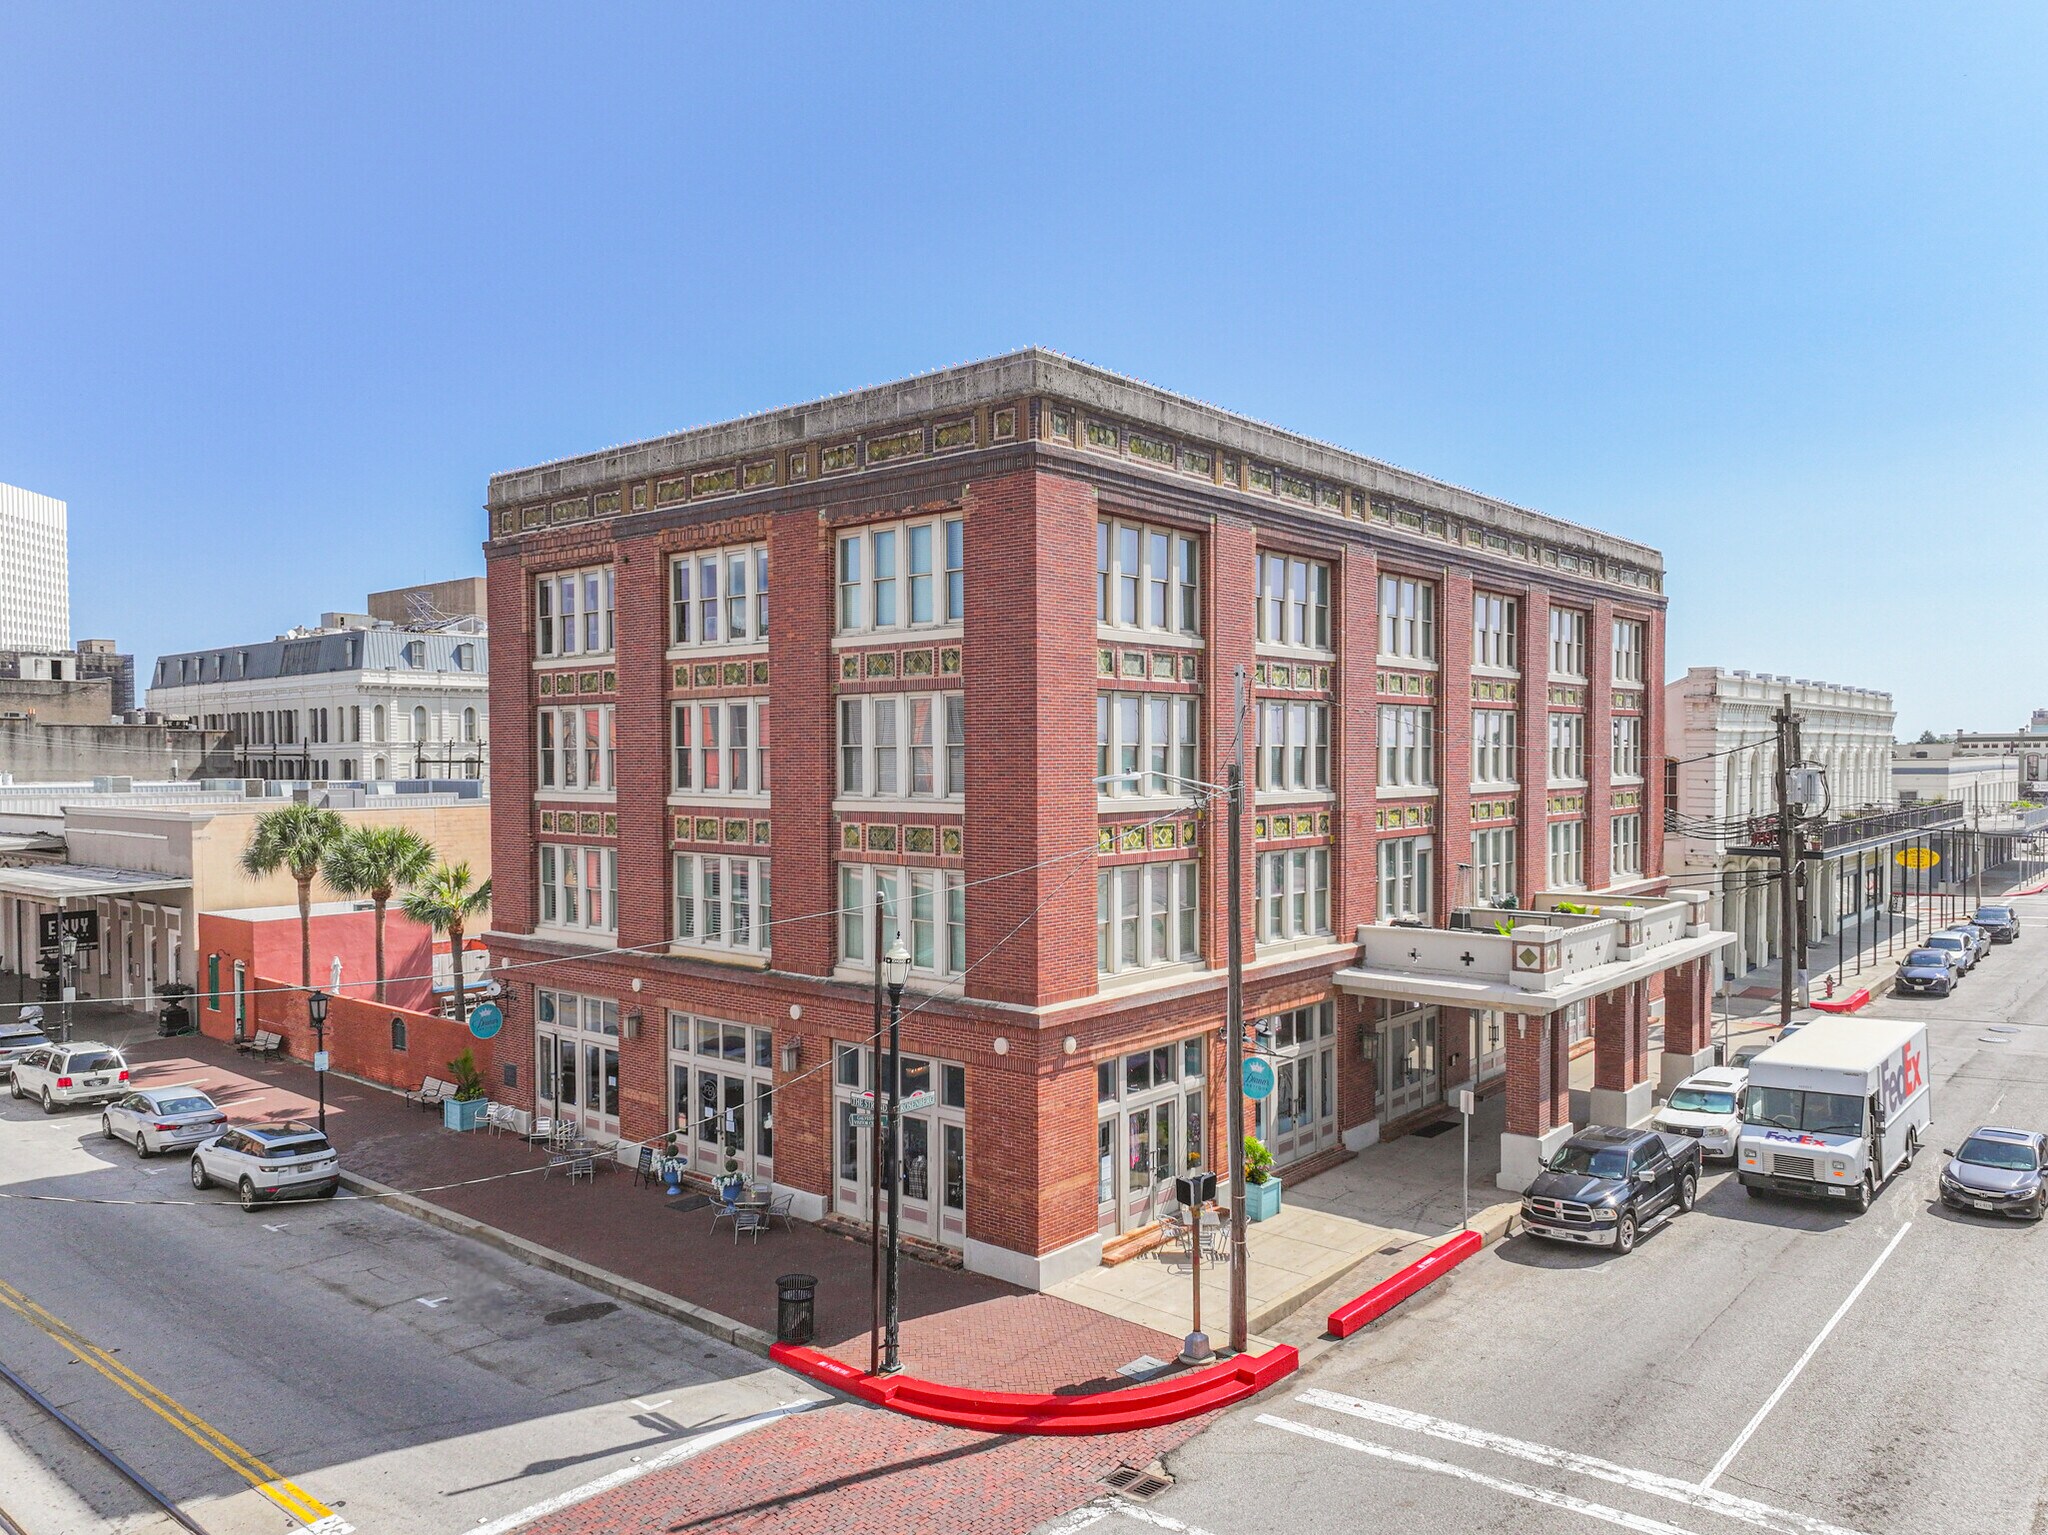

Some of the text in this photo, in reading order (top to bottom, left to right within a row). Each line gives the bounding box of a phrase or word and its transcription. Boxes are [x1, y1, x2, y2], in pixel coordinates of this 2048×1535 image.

[48, 917, 89, 936] ENVY
[1881, 1040, 1922, 1113] FedEx
[851, 1097, 888, 1113] THE STRND
[900, 1095, 935, 1113] ROSENBERG
[1765, 1130, 1827, 1147] FedEx
